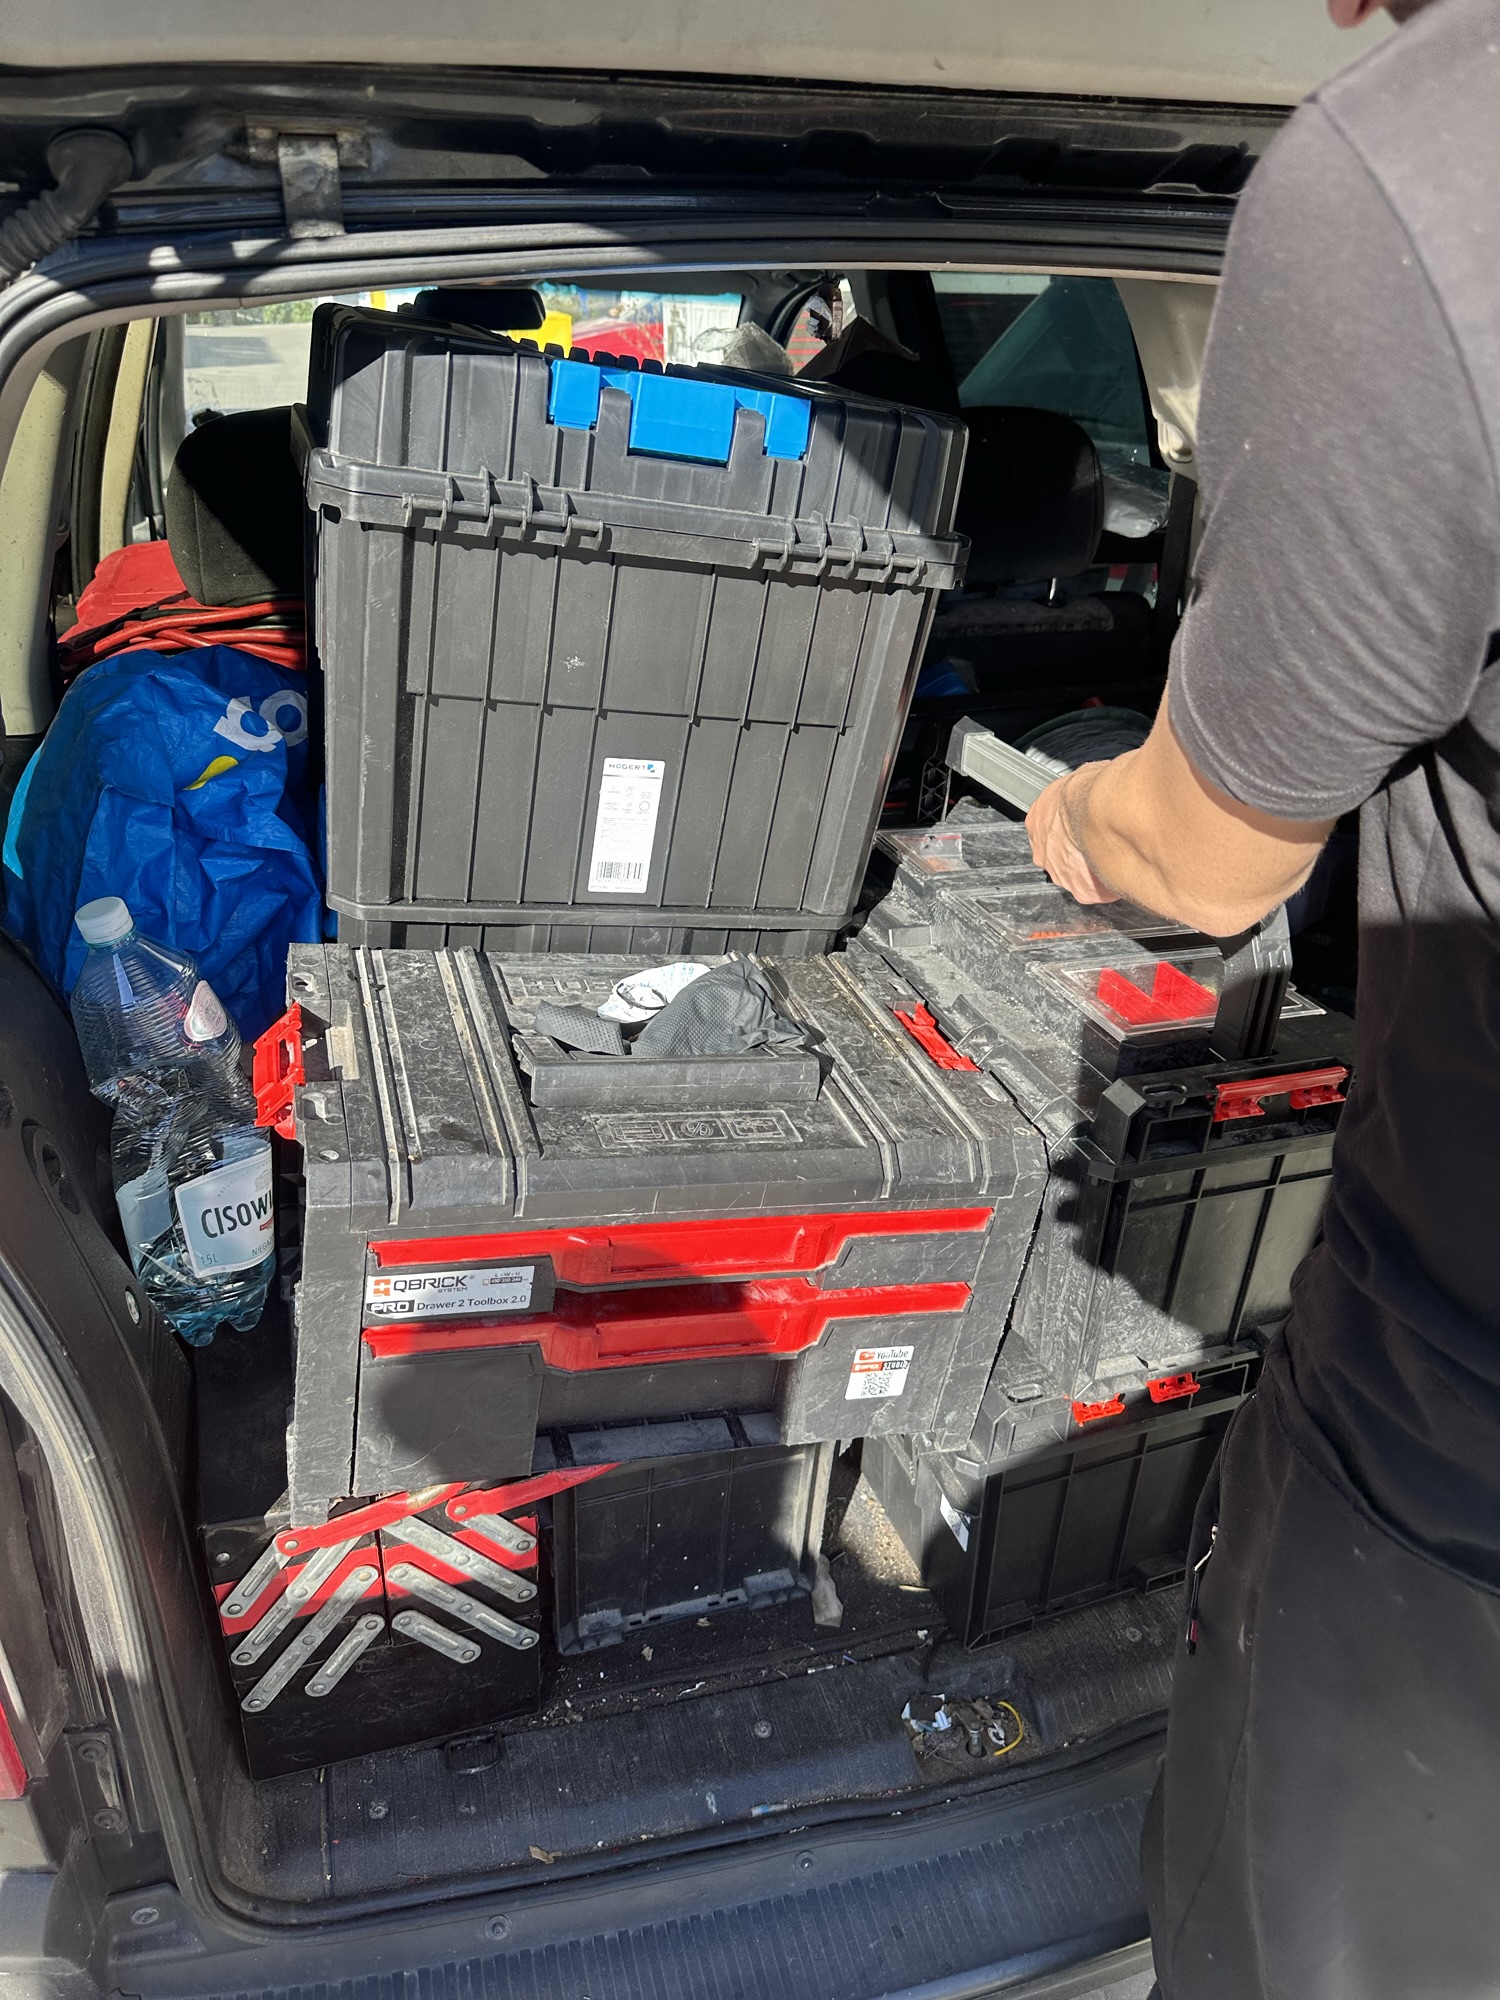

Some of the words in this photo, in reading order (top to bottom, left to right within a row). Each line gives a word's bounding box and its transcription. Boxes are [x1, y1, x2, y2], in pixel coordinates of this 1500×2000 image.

[393, 1275, 467, 1293] QBRICK
[371, 1301, 410, 1313] PRO
[417, 1301, 454, 1311] Drawer
[458, 1299, 464, 1308] 2
[467, 1294, 508, 1307] Toolbox
[511, 1294, 527, 1304] 2.0
[877, 1349, 909, 1360] YouTube
